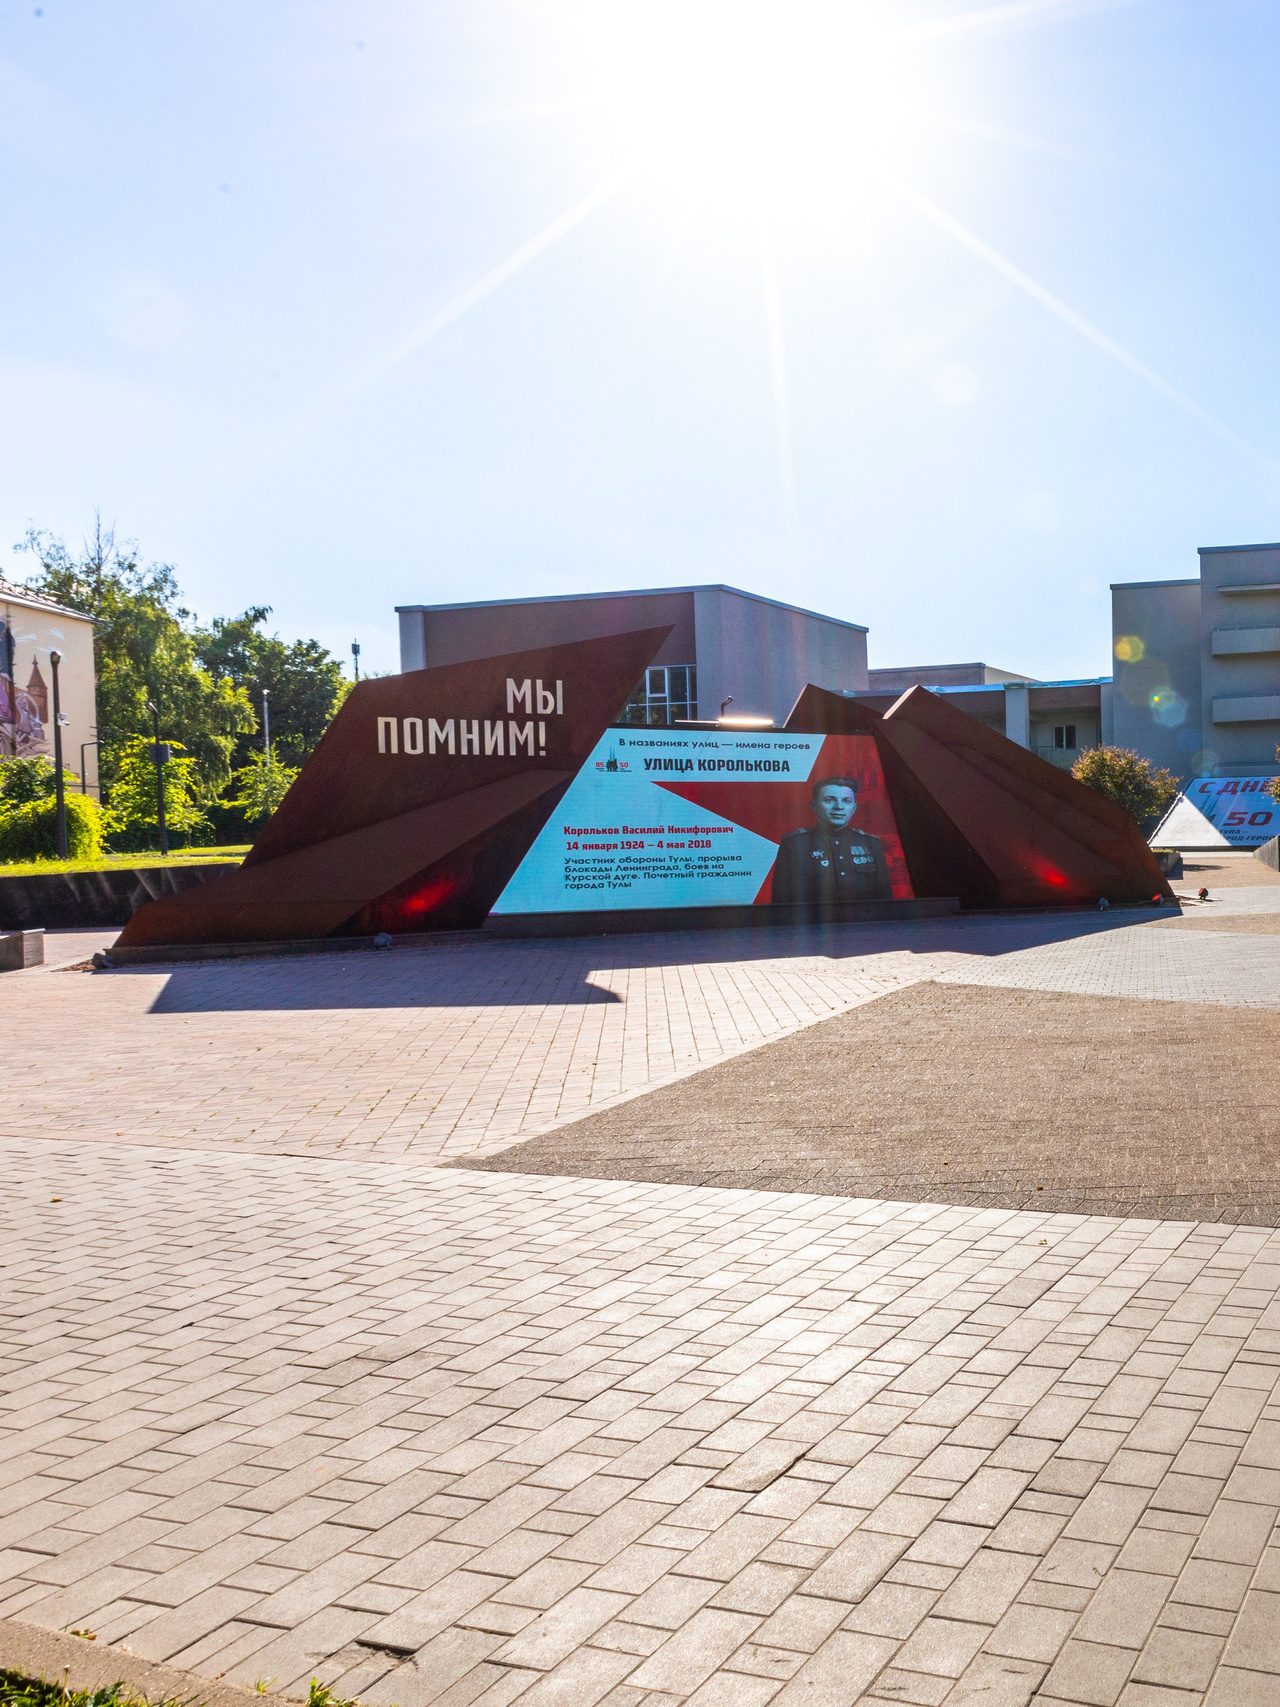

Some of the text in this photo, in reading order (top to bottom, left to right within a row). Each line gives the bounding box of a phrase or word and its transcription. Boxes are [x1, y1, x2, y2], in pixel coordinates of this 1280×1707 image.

[506, 677, 564, 715] МЫ
[377, 716, 547, 756] ПОМНИМ!
[619, 738, 625, 746] В
[629, 739, 689, 748] названиях
[692, 740, 719, 749] улиц
[735, 741, 771, 749] имена
[774, 742, 810, 751] героев
[643, 757, 790, 773] УЛИЦА КОРОЛЬКОВА
[1198, 777, 1276, 795] С ДНЁ
[1222, 811, 1273, 826] 50
[563, 825, 734, 837] Корольков Василий Никифорович
[566, 841, 579, 850] 14
[582, 842, 618, 852] января
[620, 840, 645, 849] 1924
[657, 840, 664, 849] 4
[666, 841, 685, 849] мая
[688, 839, 711, 849] 2018
[564, 854, 742, 865] Участник обороны Тулы, прорыва
[564, 864, 613, 873] блокады
[615, 863, 682, 872] Ленинграда,
[684, 862, 709, 870] боев
[565, 870, 752, 882] Курской дуге. Почетный гражданин
[565, 880, 632, 890] города Тулы
